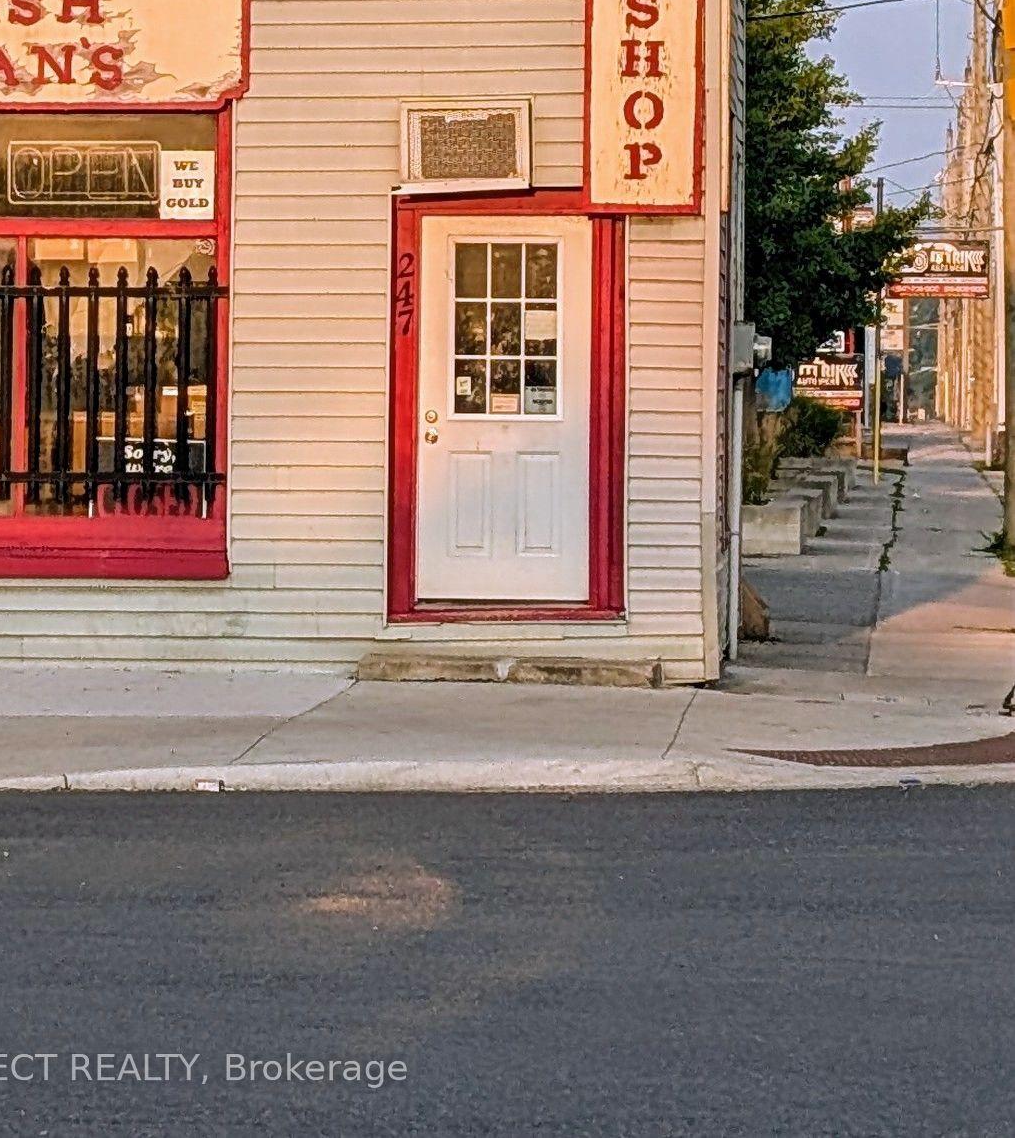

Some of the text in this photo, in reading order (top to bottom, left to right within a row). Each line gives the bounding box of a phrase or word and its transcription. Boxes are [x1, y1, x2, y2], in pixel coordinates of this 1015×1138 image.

[173, 161, 199, 171] WE
[13, 147, 156, 200] OPEN
[172, 178, 204, 189] BUY
[166, 198, 209, 209] GOLD
[395, 253, 415, 336] 247
